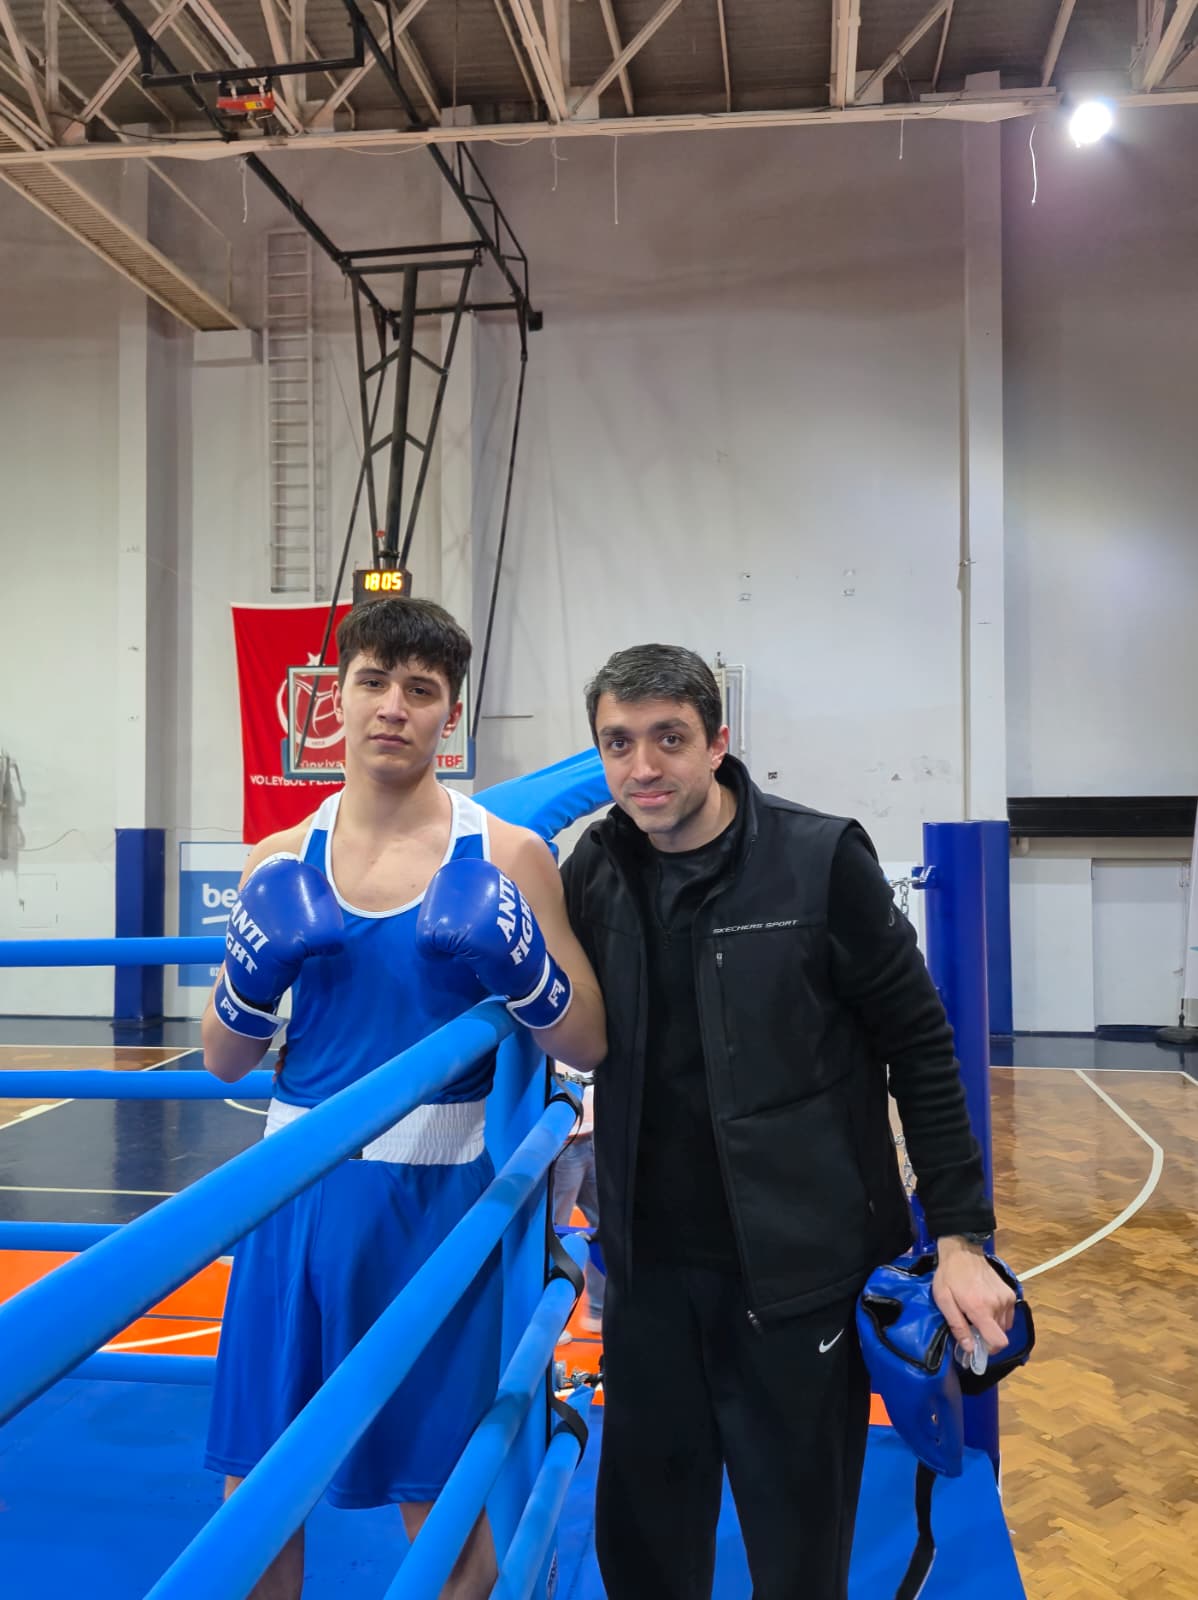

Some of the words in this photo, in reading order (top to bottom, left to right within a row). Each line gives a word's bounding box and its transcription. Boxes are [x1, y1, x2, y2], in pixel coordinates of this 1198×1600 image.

[436, 754, 464, 768] TBF
[202, 883, 238, 908] be
[229, 900, 270, 953] ANTI
[510, 889, 533, 966] FIGH
[713, 923, 763, 934] SKECHERS
[765, 920, 799, 928] SPORT
[226, 932, 258, 976] GHT
